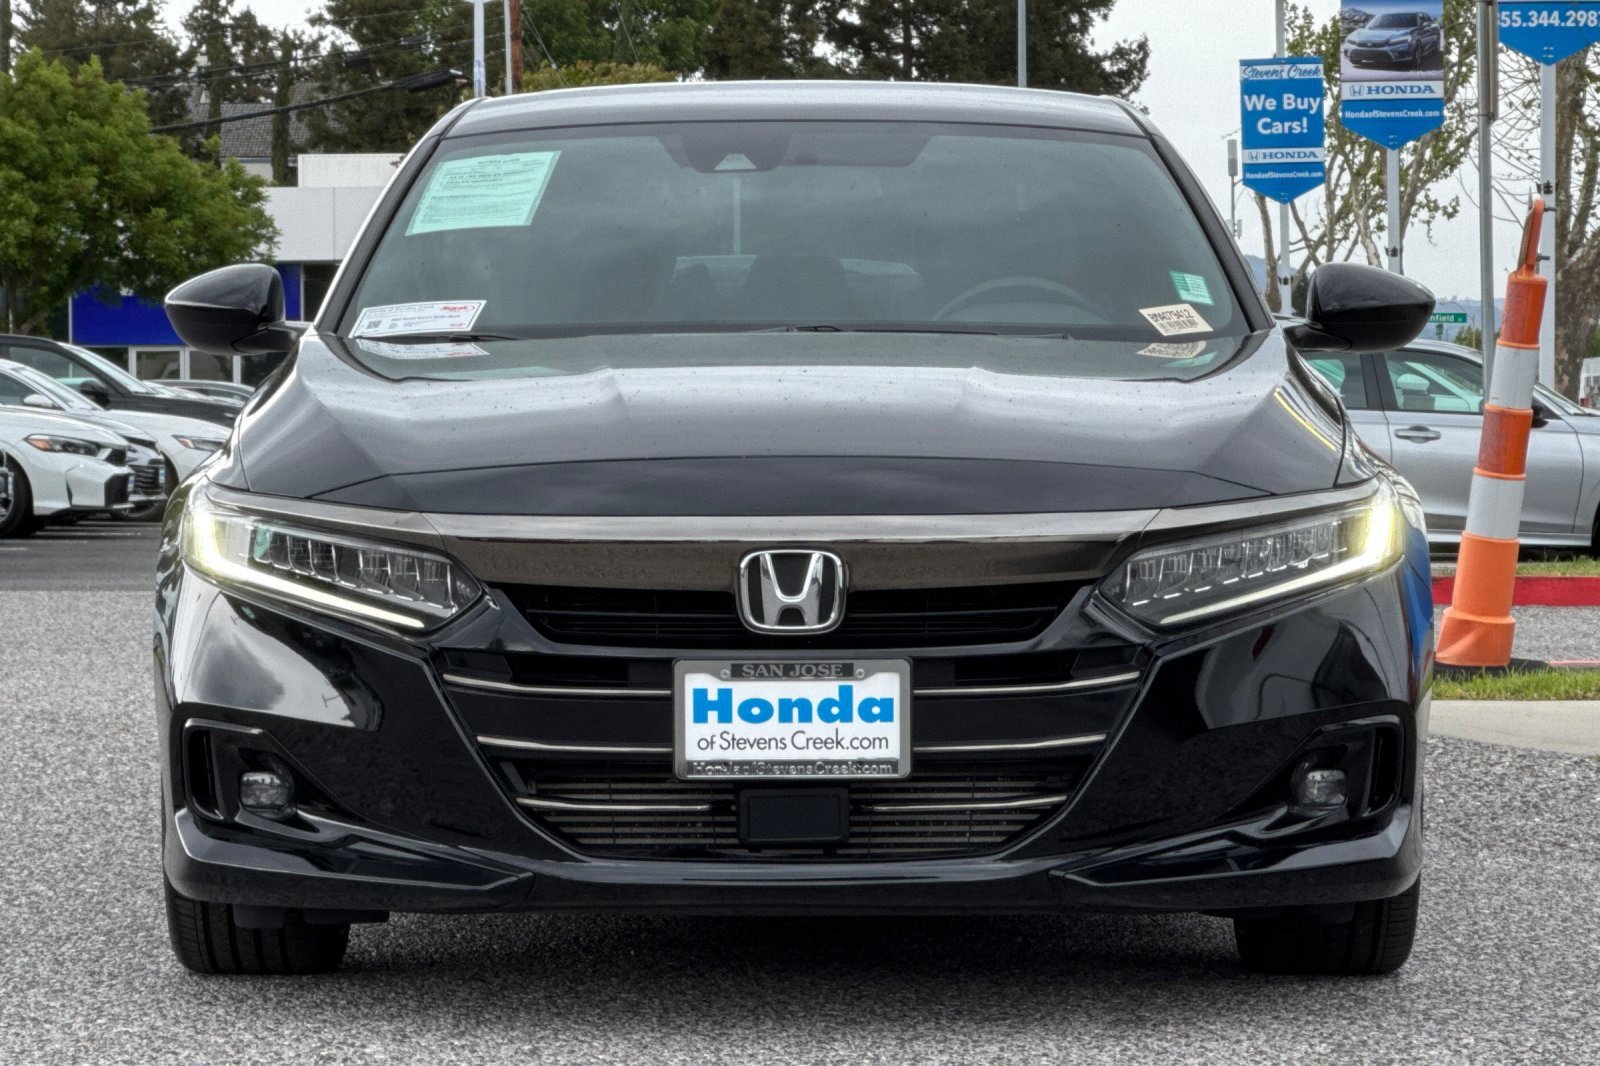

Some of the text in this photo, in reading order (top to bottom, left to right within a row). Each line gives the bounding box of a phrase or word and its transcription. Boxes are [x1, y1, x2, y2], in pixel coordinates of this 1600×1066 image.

[1243, 64, 1321, 79] Stevens Creek
[1366, 84, 1436, 95] HONDA
[1243, 93, 1320, 114] We Buy
[1345, 109, 1440, 118] HondaofStevensCreek.com
[1257, 116, 1308, 134] Cars!
[1262, 151, 1319, 160] HONDA
[742, 664, 843, 677] SAN JOSE
[692, 684, 894, 724] Honda
[697, 727, 889, 751] of Stevens Creek.com
